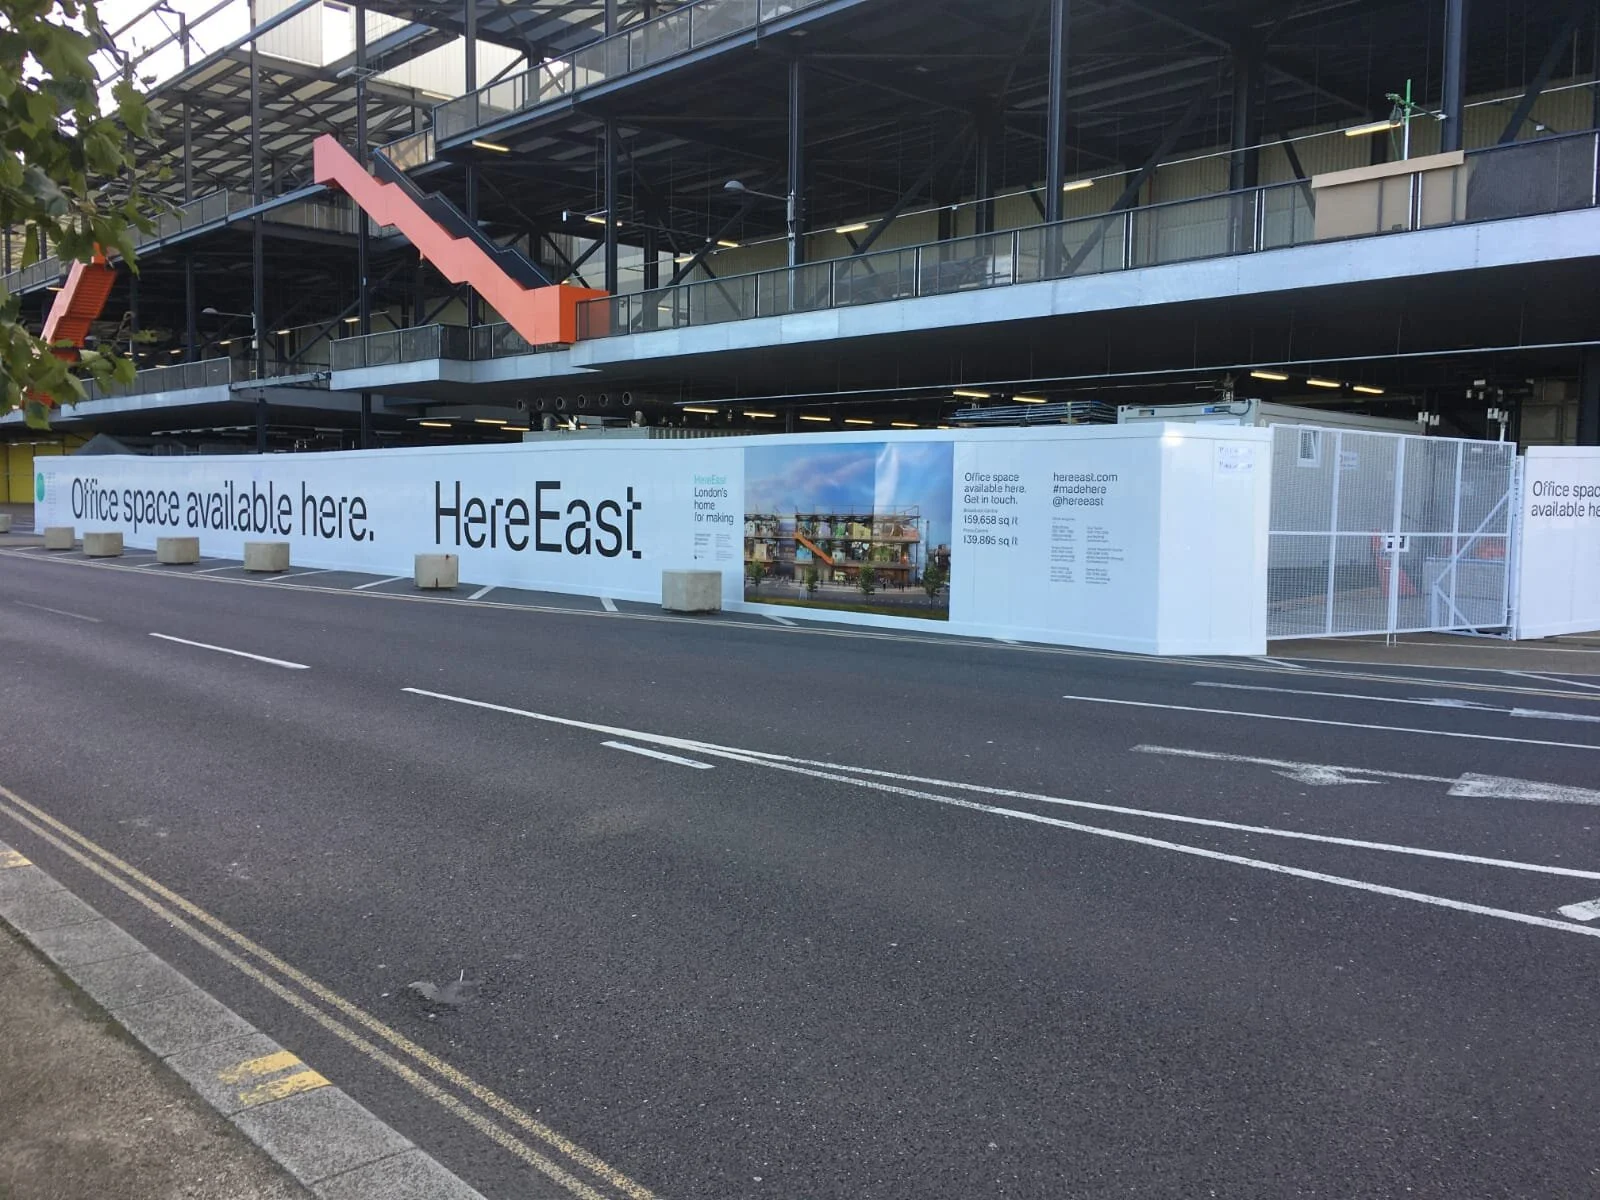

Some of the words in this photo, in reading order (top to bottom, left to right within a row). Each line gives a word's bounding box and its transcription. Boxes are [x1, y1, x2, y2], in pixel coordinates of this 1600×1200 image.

[964, 472, 990, 482] Office
[992, 474, 1020, 483] space
[1053, 472, 1118, 482] hereeast.com
[694, 487, 728, 498] London's
[964, 484, 1003, 493] available
[1004, 484, 1027, 494] here.
[1053, 484, 1107, 494] #madehere
[1533, 480, 1570, 497] Office
[694, 500, 715, 510] home
[964, 495, 979, 504] Get
[981, 496, 988, 504] in
[991, 496, 1018, 504] touch.
[1052, 496, 1104, 507] @hereeast
[72, 478, 119, 521] Office
[123, 489, 180, 534] space
[186, 480, 292, 535] available
[302, 481, 374, 541] here.
[1531, 501, 1585, 517] available
[435, 480, 642, 559] HereEast
[694, 511, 704, 522] for
[706, 513, 734, 525] making
[998, 517, 1010, 526] sq
[998, 537, 1010, 547] sq
